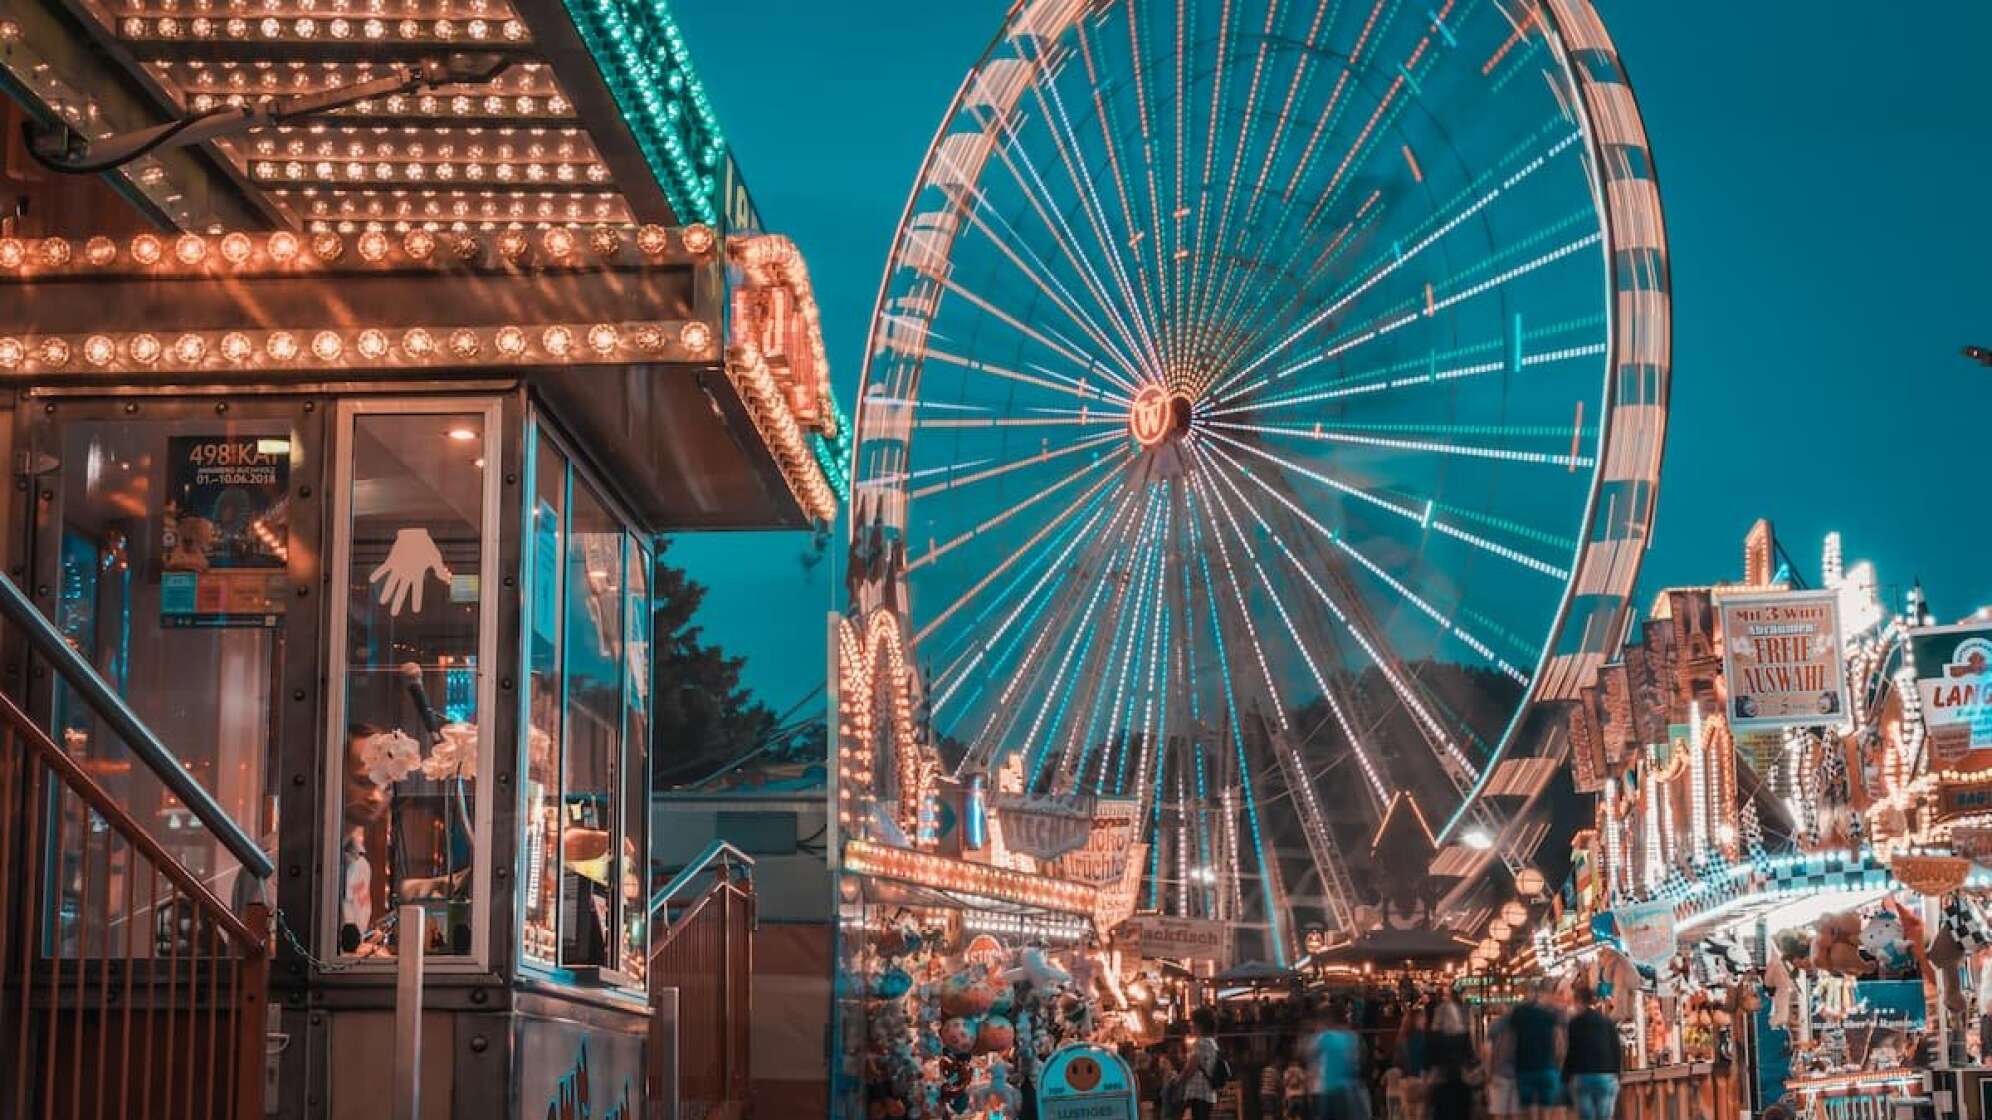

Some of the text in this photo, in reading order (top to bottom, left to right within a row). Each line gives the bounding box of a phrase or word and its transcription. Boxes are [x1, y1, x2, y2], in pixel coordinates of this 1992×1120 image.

[1765, 606, 1779, 621] 3
[1753, 636, 1809, 664] FREIE
[1743, 665, 1825, 694] AUSWAHL
